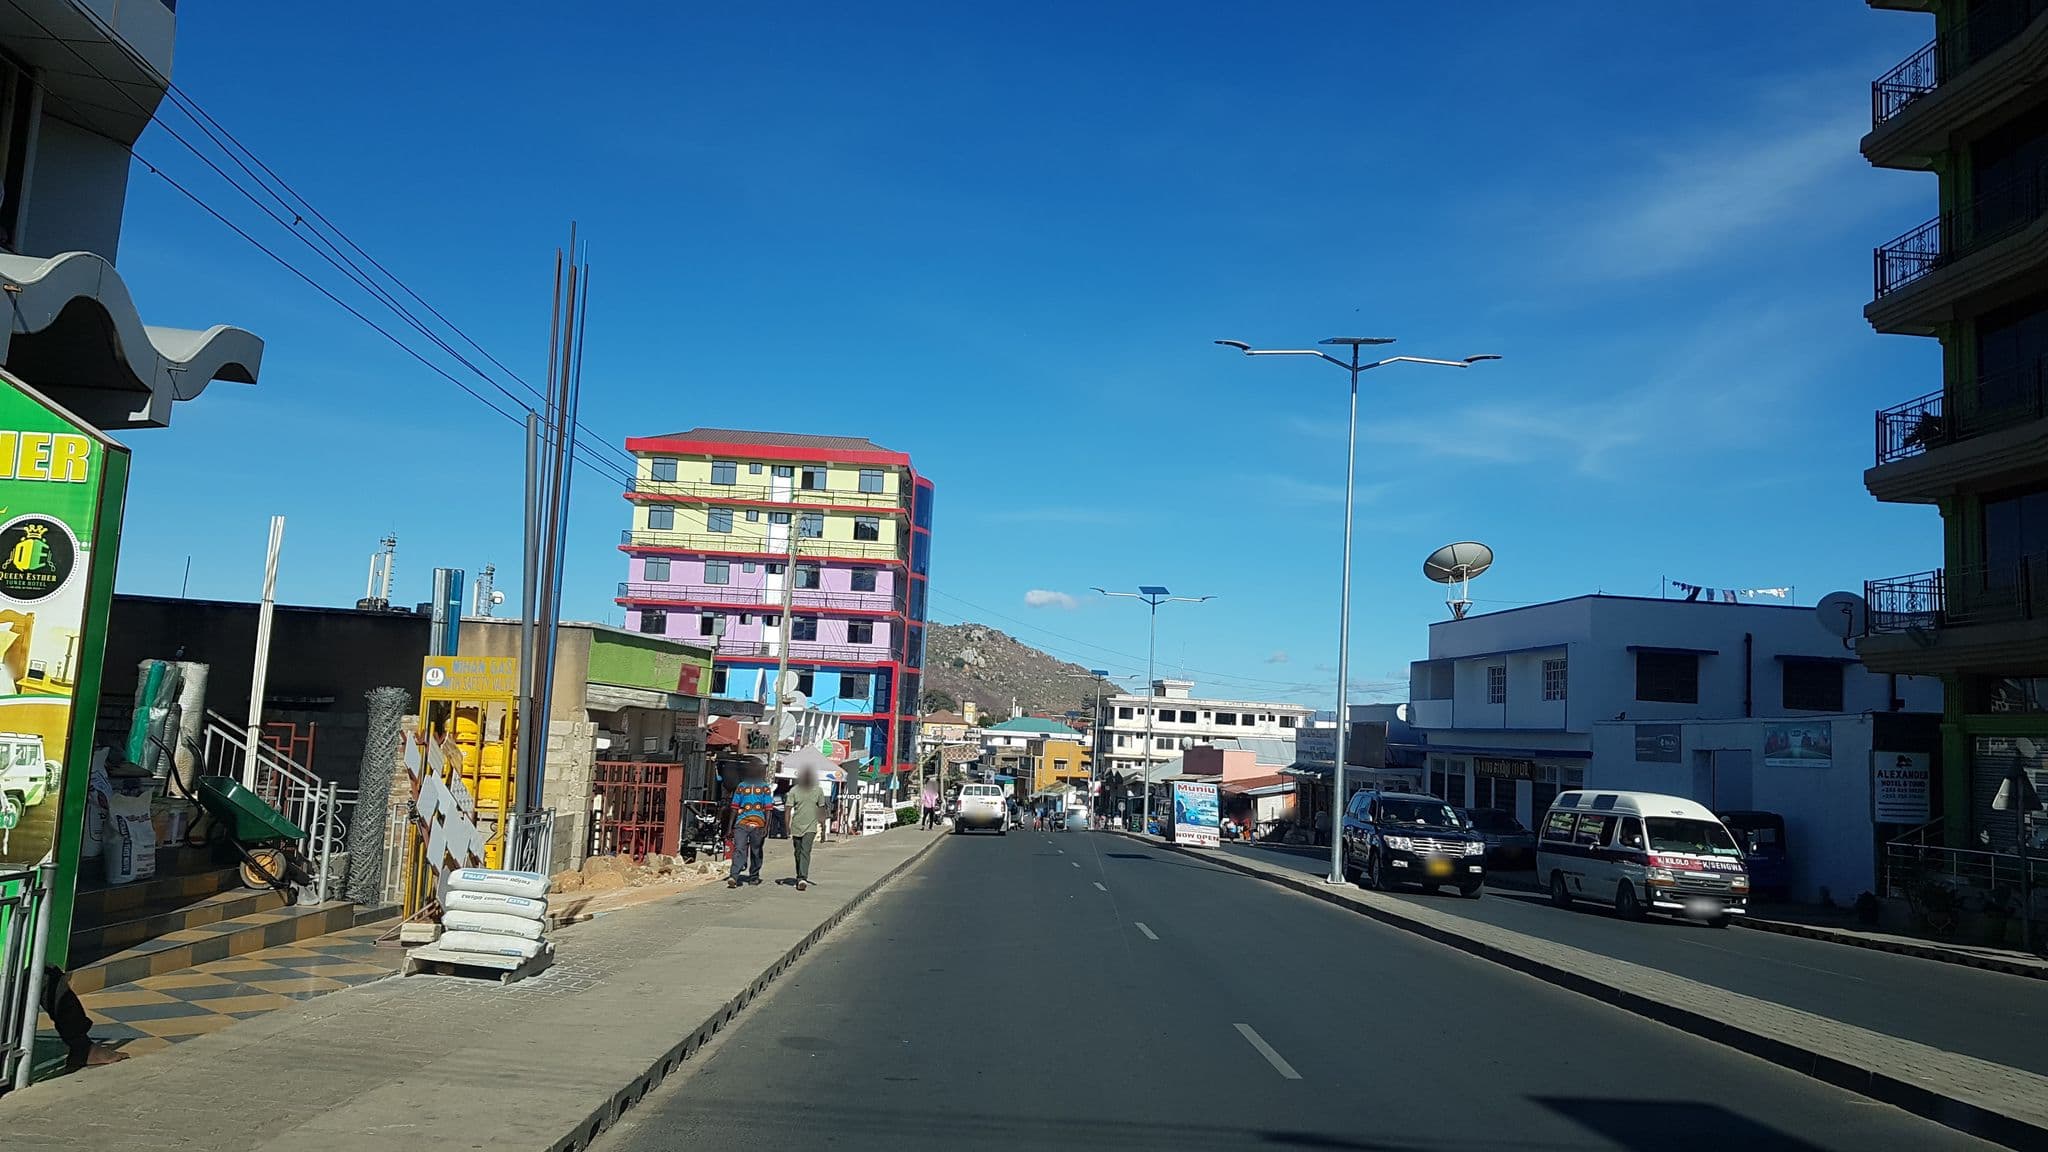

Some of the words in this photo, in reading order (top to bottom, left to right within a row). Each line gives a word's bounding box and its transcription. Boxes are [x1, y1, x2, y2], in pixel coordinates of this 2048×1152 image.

[0, 571, 23, 581] QUEEN
[26, 572, 57, 582] ESTHER
[27, 580, 47, 588] HOTEL
[491, 660, 513, 675] GAS
[1877, 770, 1928, 779] ALEXANDER
[1196, 833, 1219, 841] OPEN
